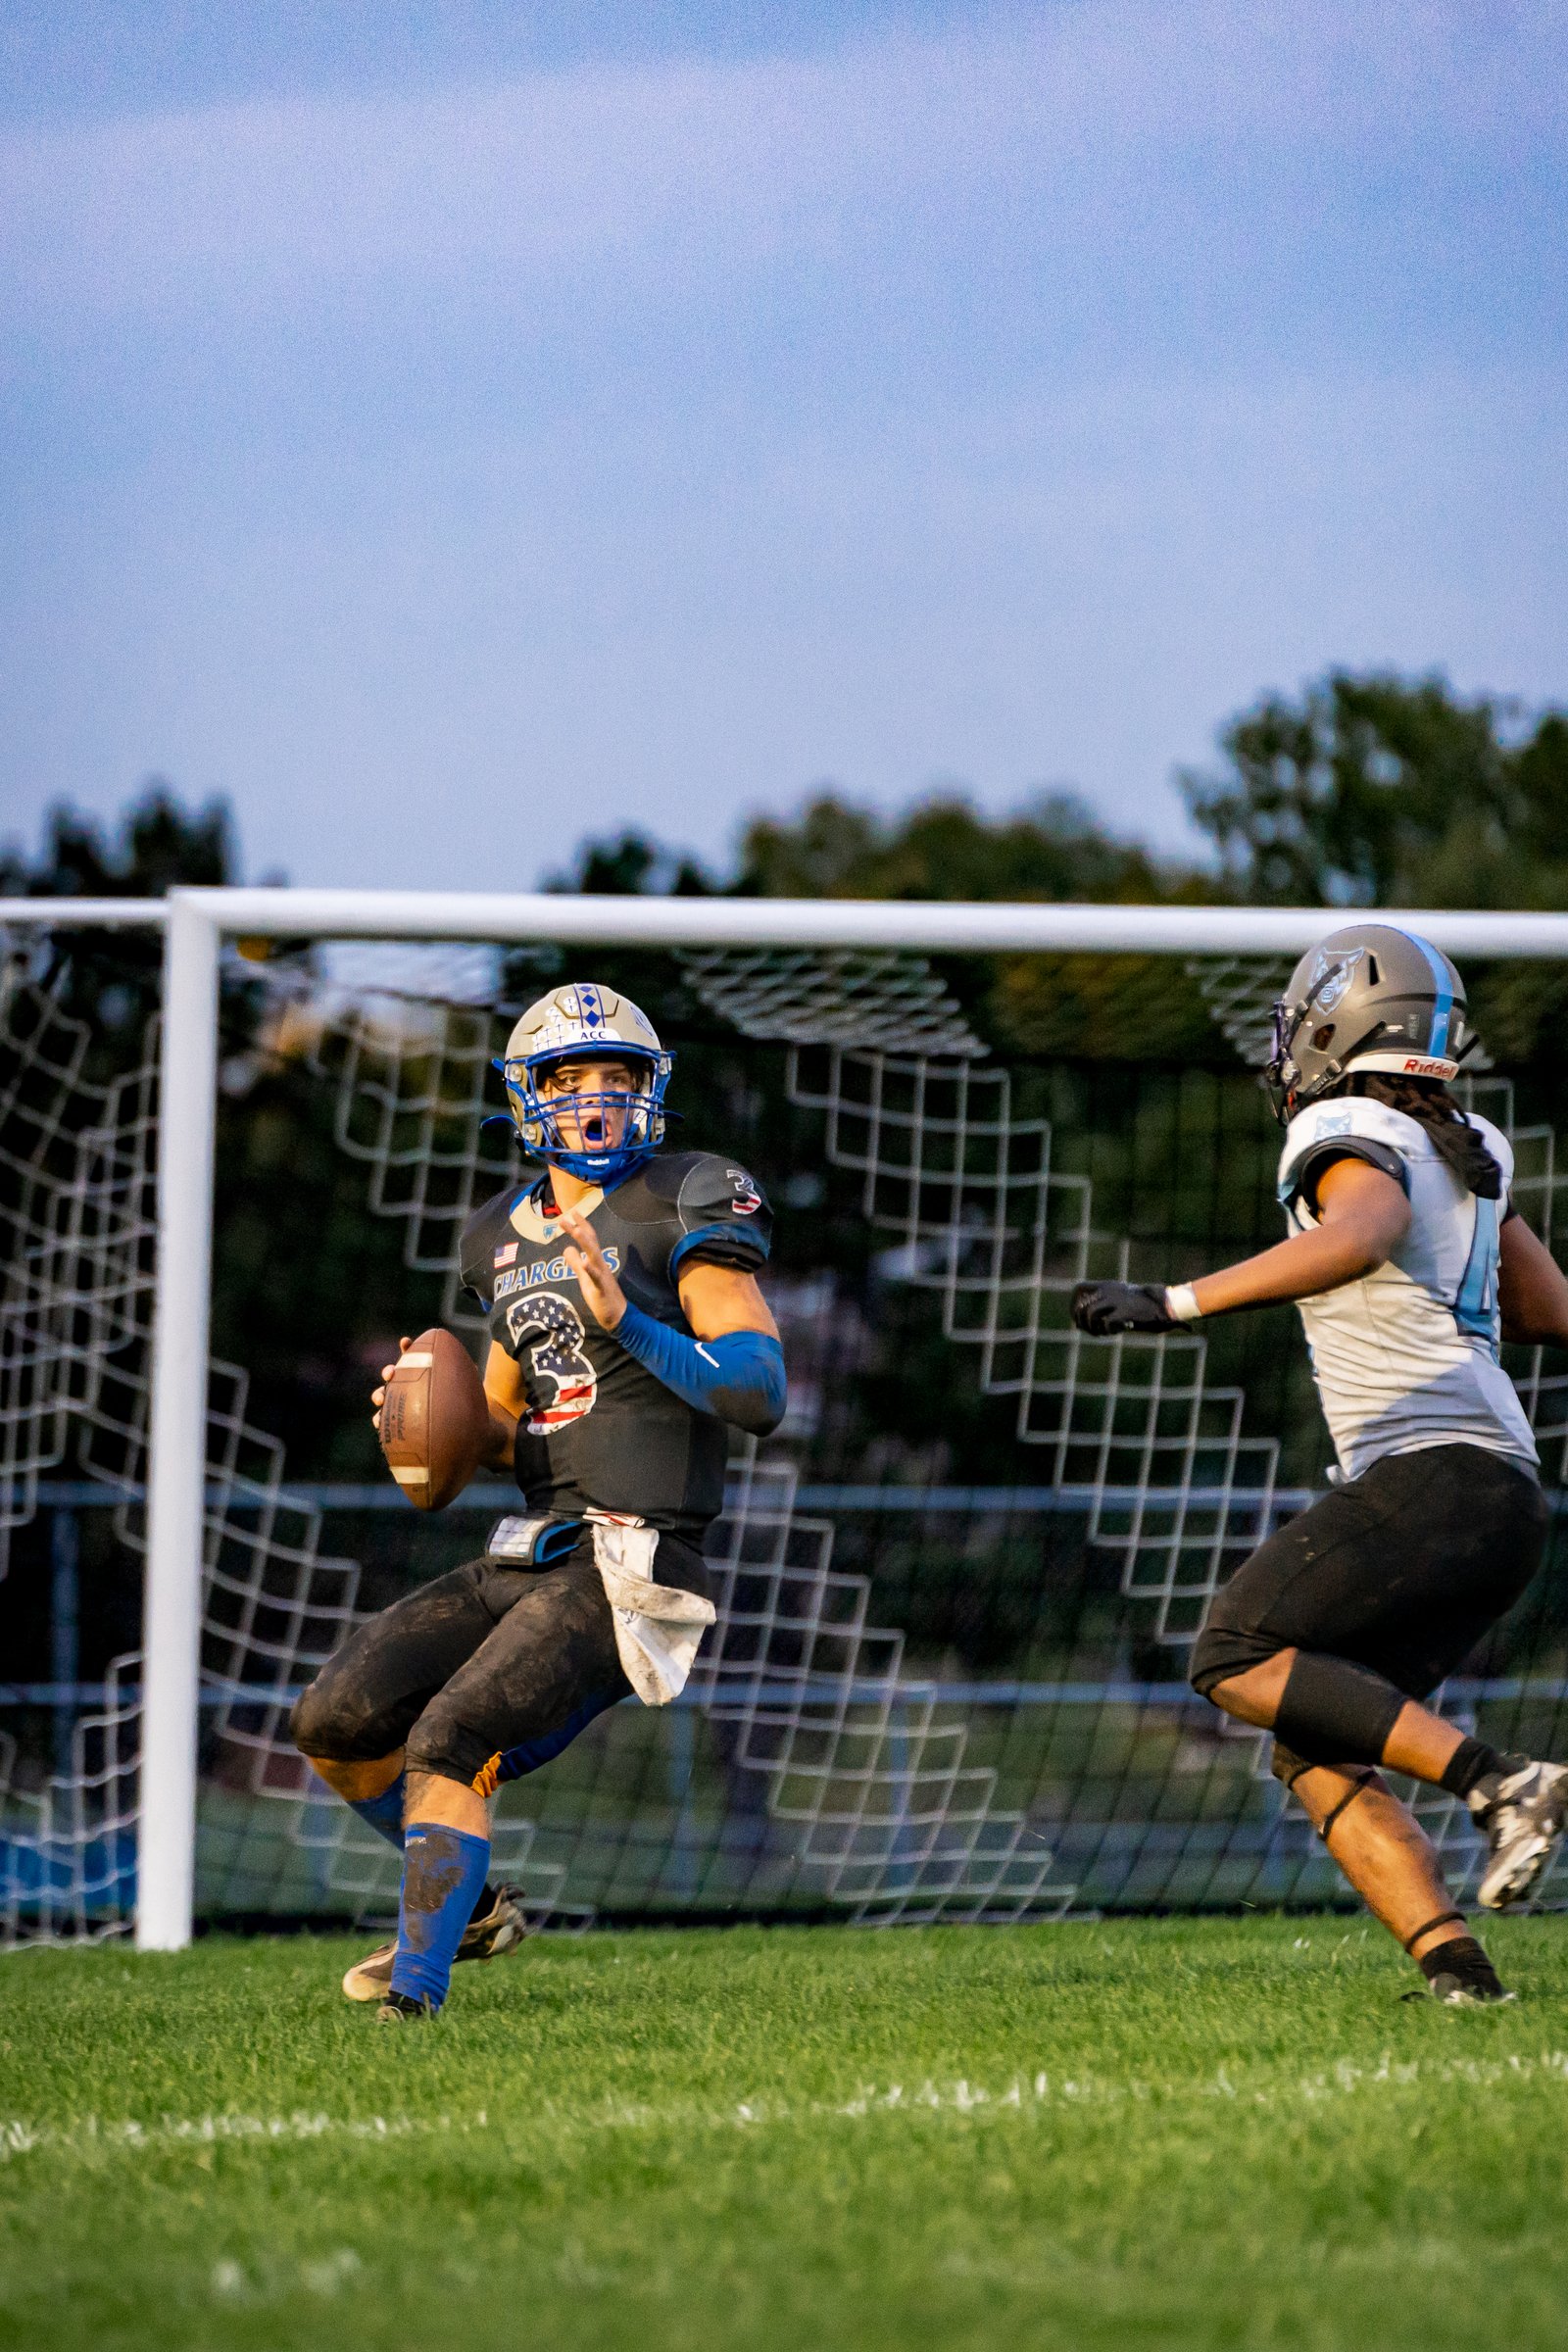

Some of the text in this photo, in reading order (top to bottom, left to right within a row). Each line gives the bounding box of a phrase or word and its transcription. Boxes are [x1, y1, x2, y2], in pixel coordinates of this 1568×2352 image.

[580, 1030, 608, 1040] ACC
[726, 1169, 761, 1214] 3
[506, 1291, 598, 1436] 3
